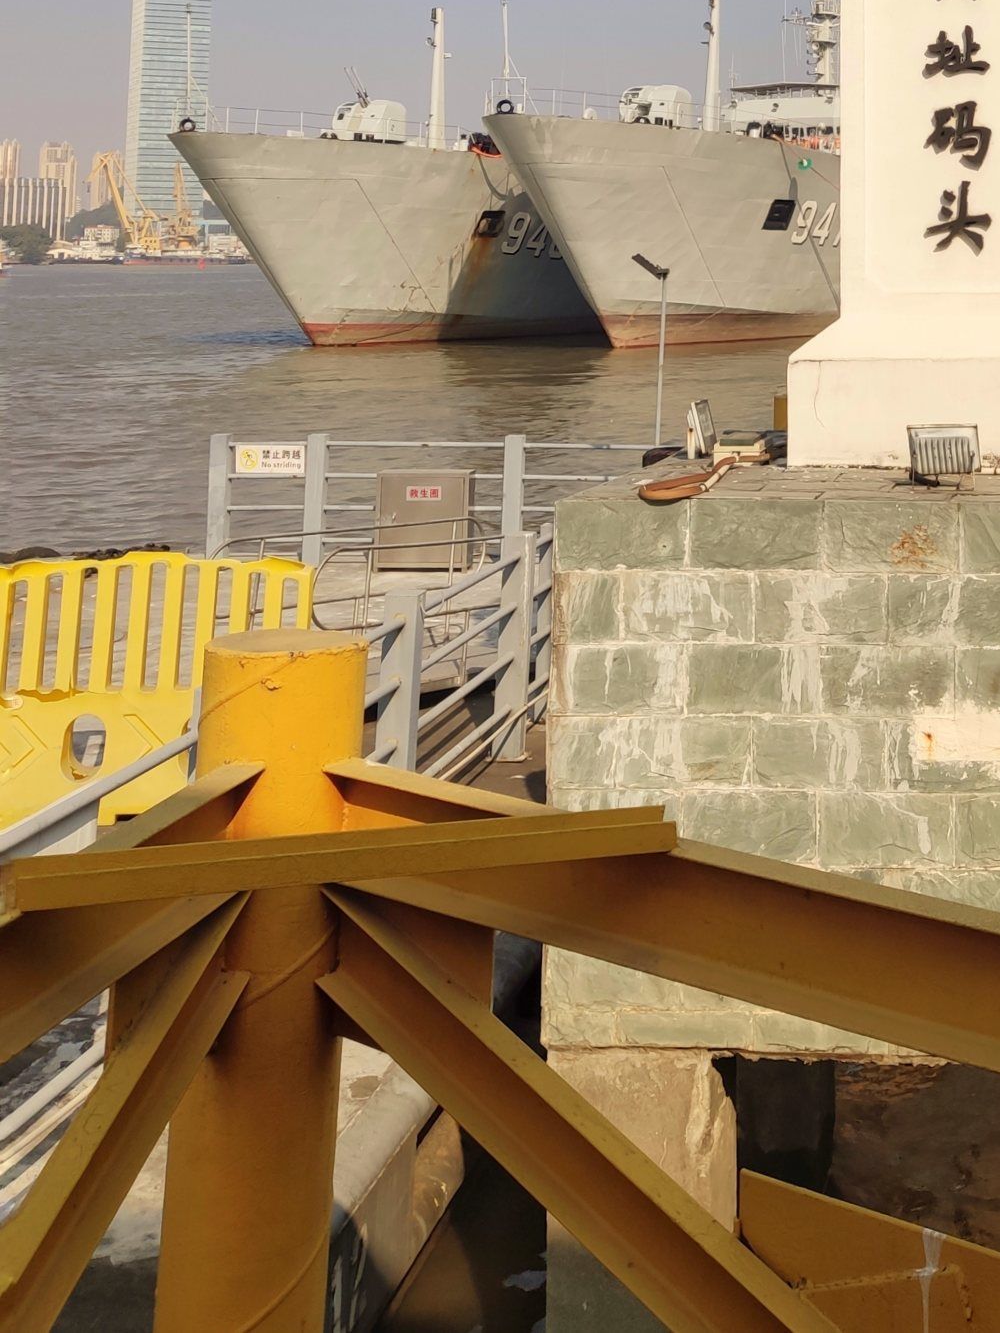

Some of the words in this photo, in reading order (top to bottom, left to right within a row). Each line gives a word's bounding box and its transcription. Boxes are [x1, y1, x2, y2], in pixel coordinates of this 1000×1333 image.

[791, 200, 840, 247] 94
[262, 449, 301, 460] 禁止跨越
[273, 461, 302, 469] striding
